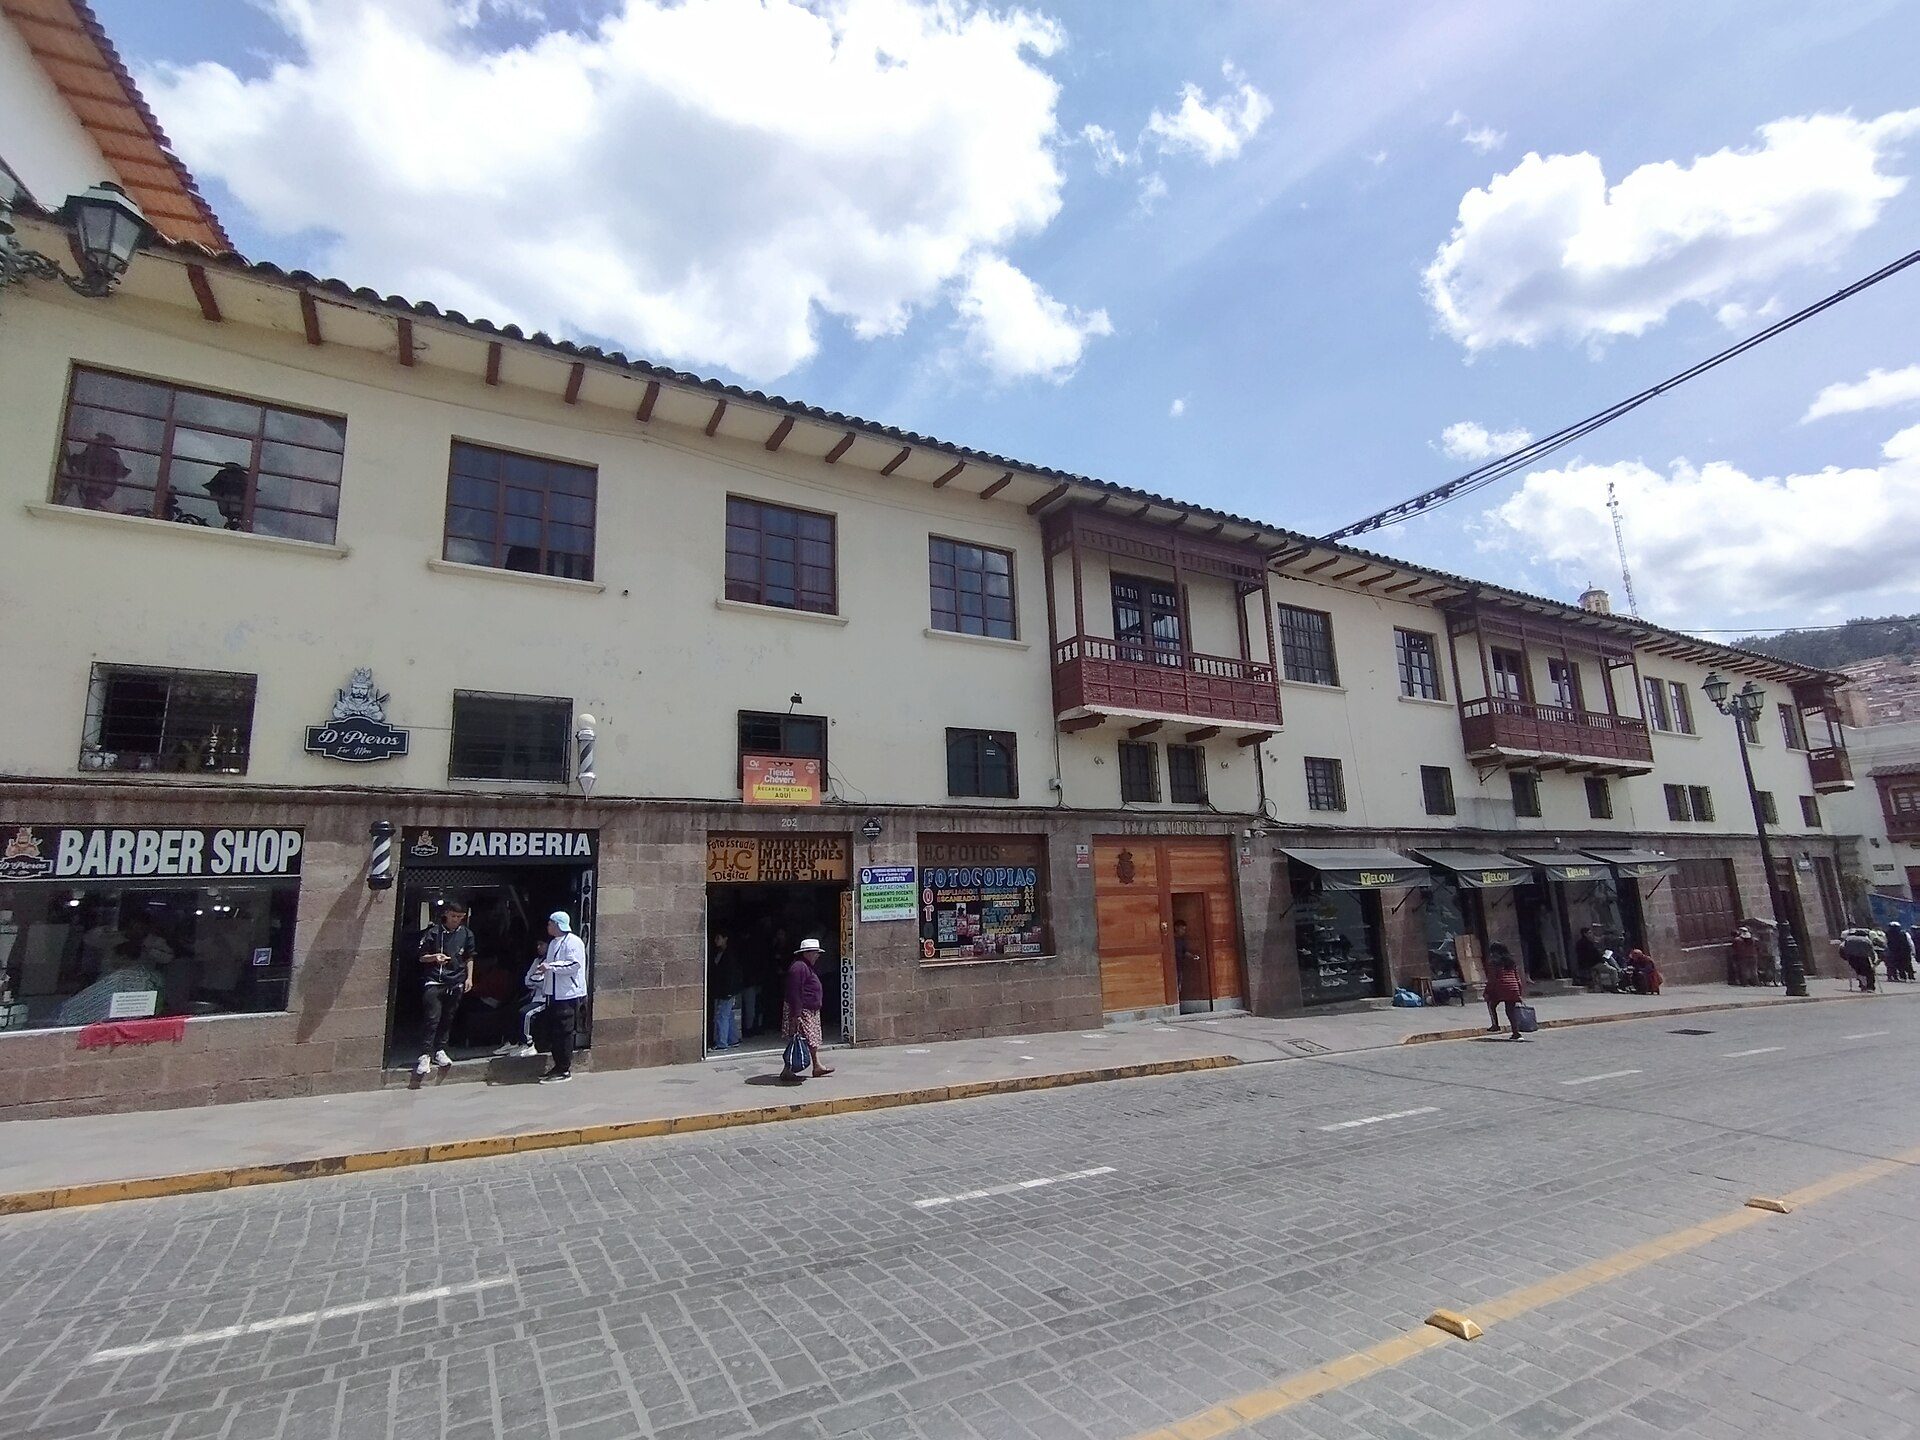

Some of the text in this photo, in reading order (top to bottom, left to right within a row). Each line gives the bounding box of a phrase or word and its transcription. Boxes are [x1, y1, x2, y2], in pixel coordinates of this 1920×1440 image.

[318, 729, 399, 745] D'Pieros
[769, 768, 794, 776] Tienda
[764, 775, 796, 784] Chévere
[781, 818, 798, 827] 202
[448, 831, 592, 857] BARBERIA
[706, 838, 755, 850] Foto Estudio
[758, 839, 838, 849] FOTOCOPIAS
[55, 829, 302, 876] BARBER SHOP
[758, 849, 843, 860] IMPRESIONES
[948, 844, 1000, 861] FOTOS
[758, 859, 816, 870] PLOTEOS
[712, 871, 749, 881] Digital
[758, 869, 799, 880] FOTOS
[923, 867, 1037, 888] FOTOCOPIAS
